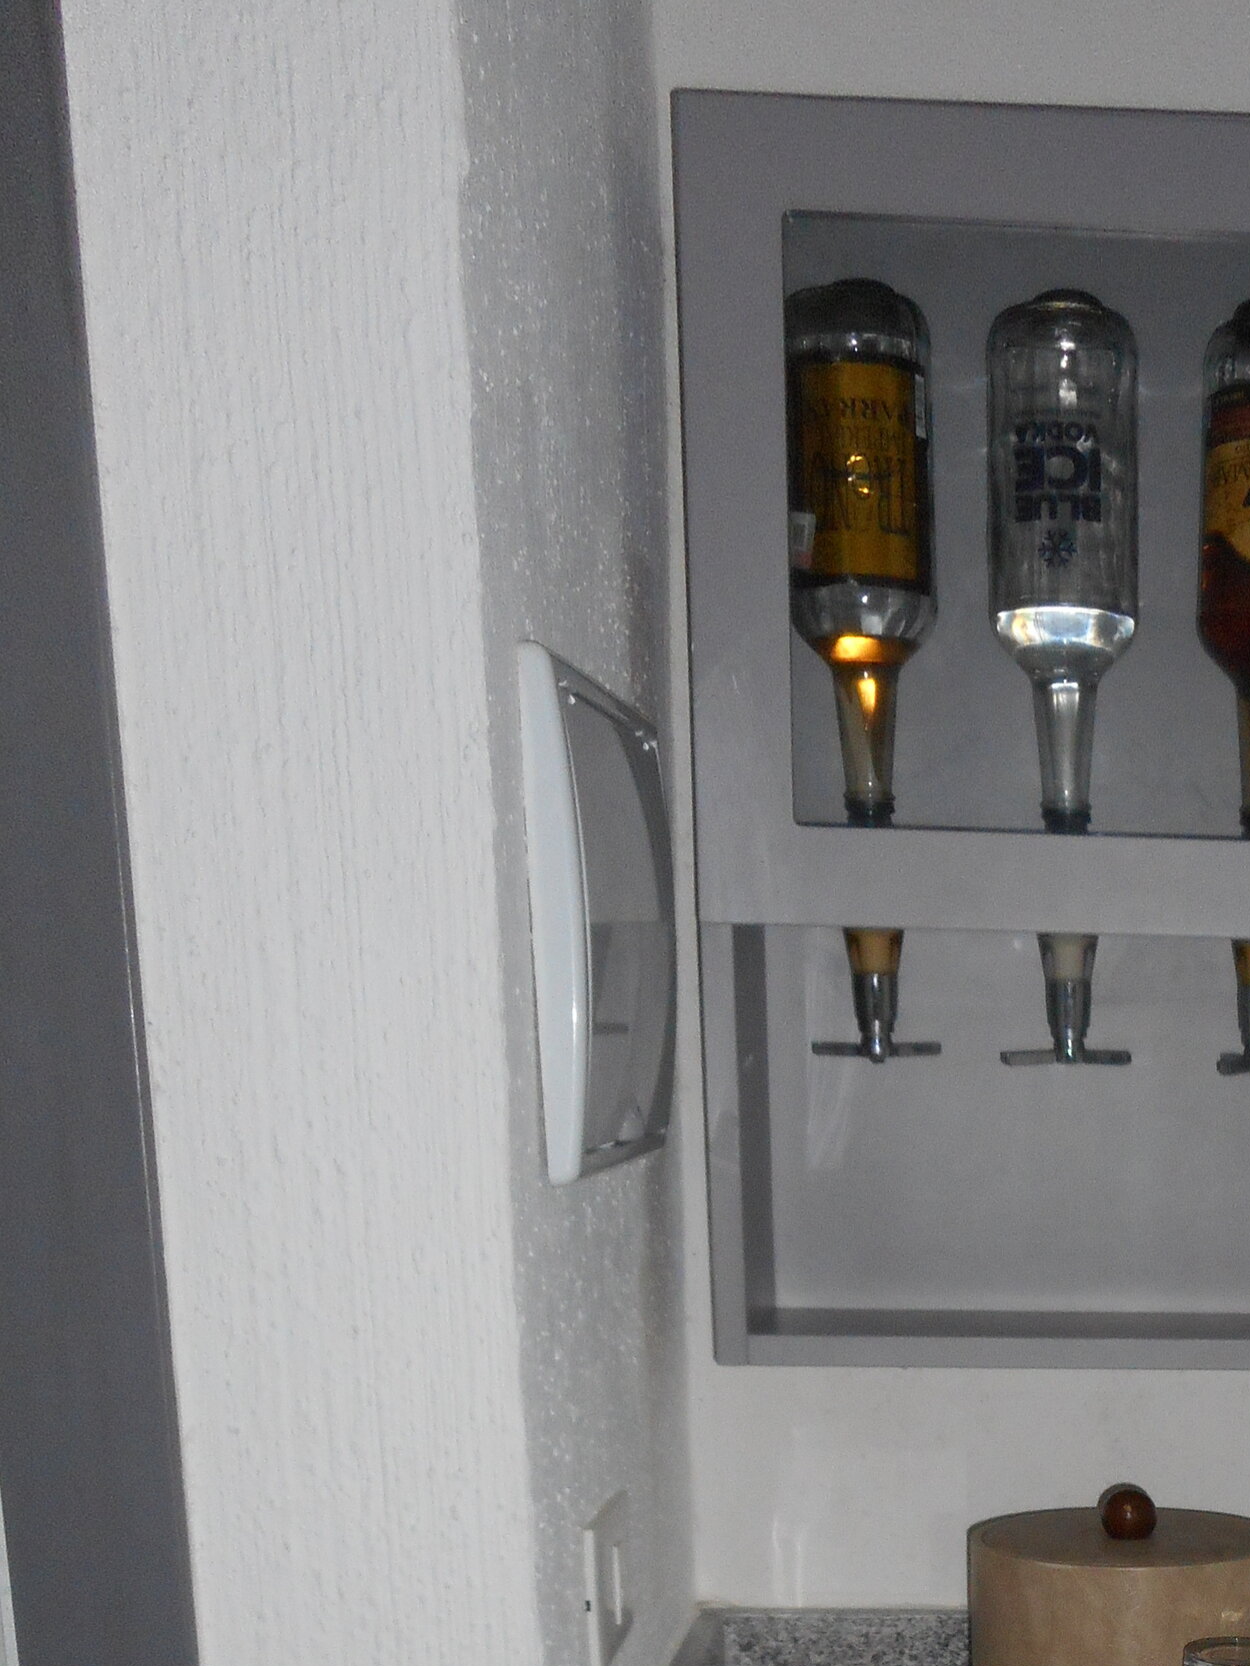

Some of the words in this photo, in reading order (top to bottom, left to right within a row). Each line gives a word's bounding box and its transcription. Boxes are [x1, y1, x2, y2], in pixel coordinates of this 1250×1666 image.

[1015, 421, 1099, 444] VODKA
[1014, 447, 1101, 492] ICE
[1015, 495, 1101, 523] BLUE
